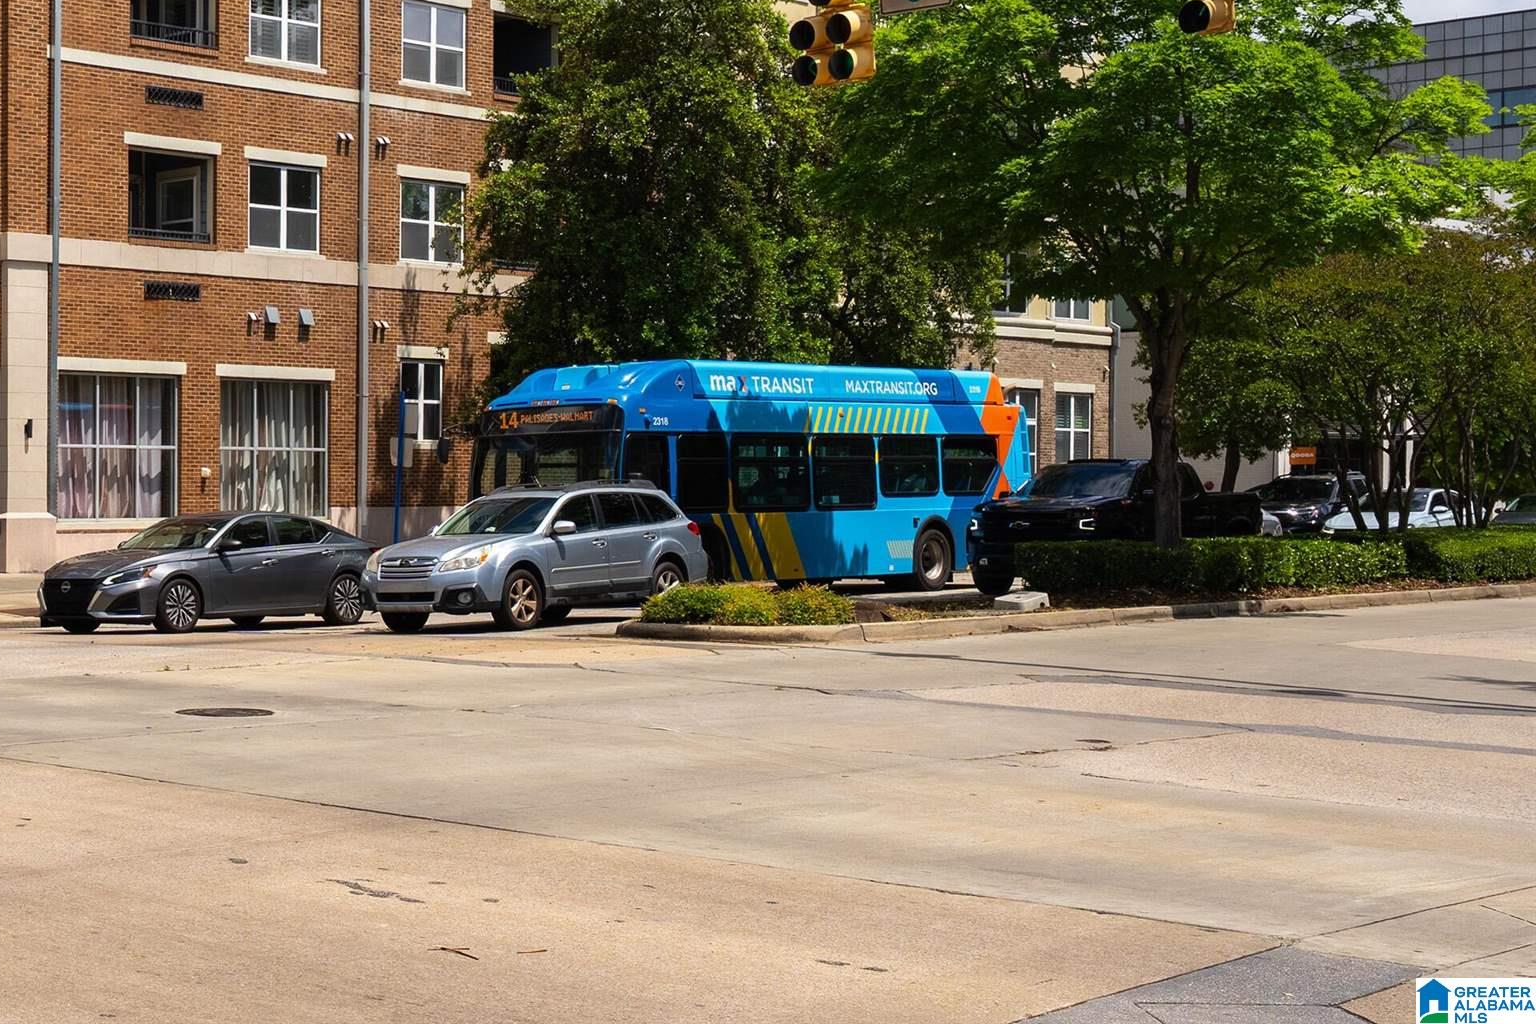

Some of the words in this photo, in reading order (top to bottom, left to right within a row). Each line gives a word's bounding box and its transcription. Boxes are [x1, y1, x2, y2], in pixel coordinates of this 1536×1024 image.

[709, 374, 748, 394] max
[751, 375, 814, 394] TRANSIT
[845, 379, 938, 396] MAXTRANSIT.ORG
[499, 411, 520, 430] 14
[652, 416, 669, 426] 2318
